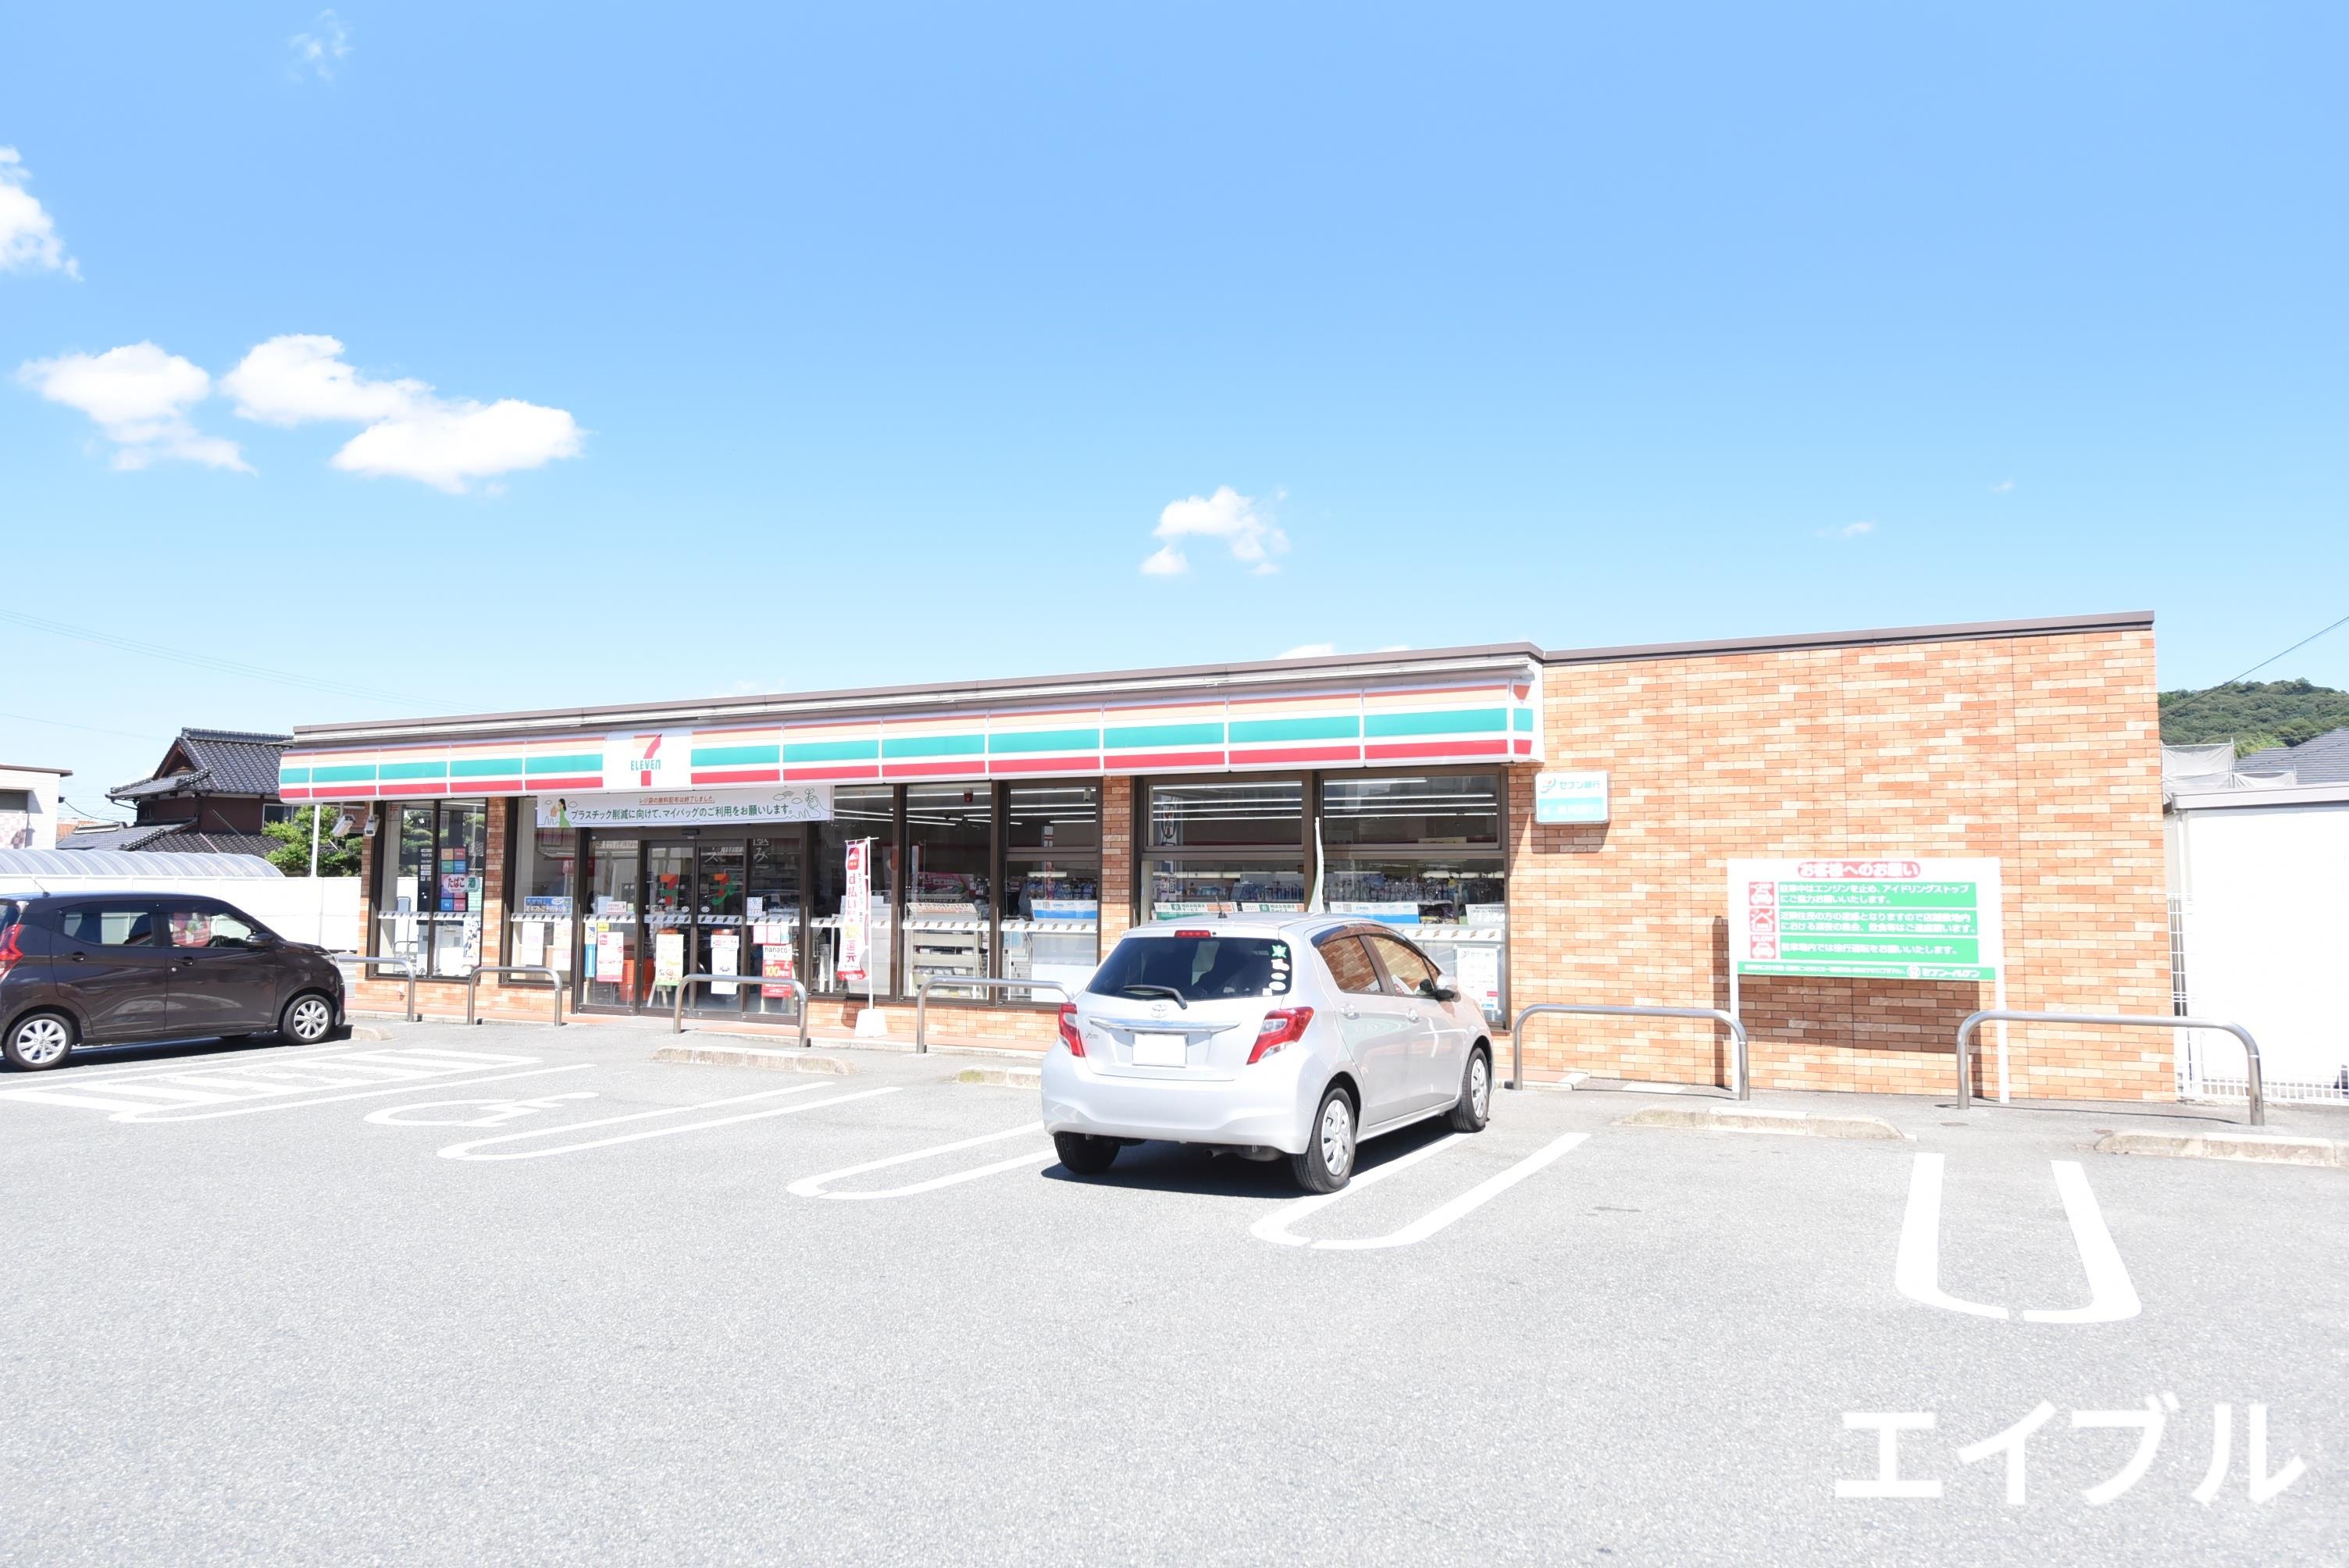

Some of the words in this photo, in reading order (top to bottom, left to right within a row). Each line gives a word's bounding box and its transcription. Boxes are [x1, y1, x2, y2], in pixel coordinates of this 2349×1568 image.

[639, 796, 715, 804] レジ袋の無料配布は終了しました。
[571, 803, 793, 821] プラスチック削減に向けて、マイバッグのご利用をお願いします。
[1799, 862, 1919, 878] お客様へのお願い
[447, 876, 465, 888] たばこ
